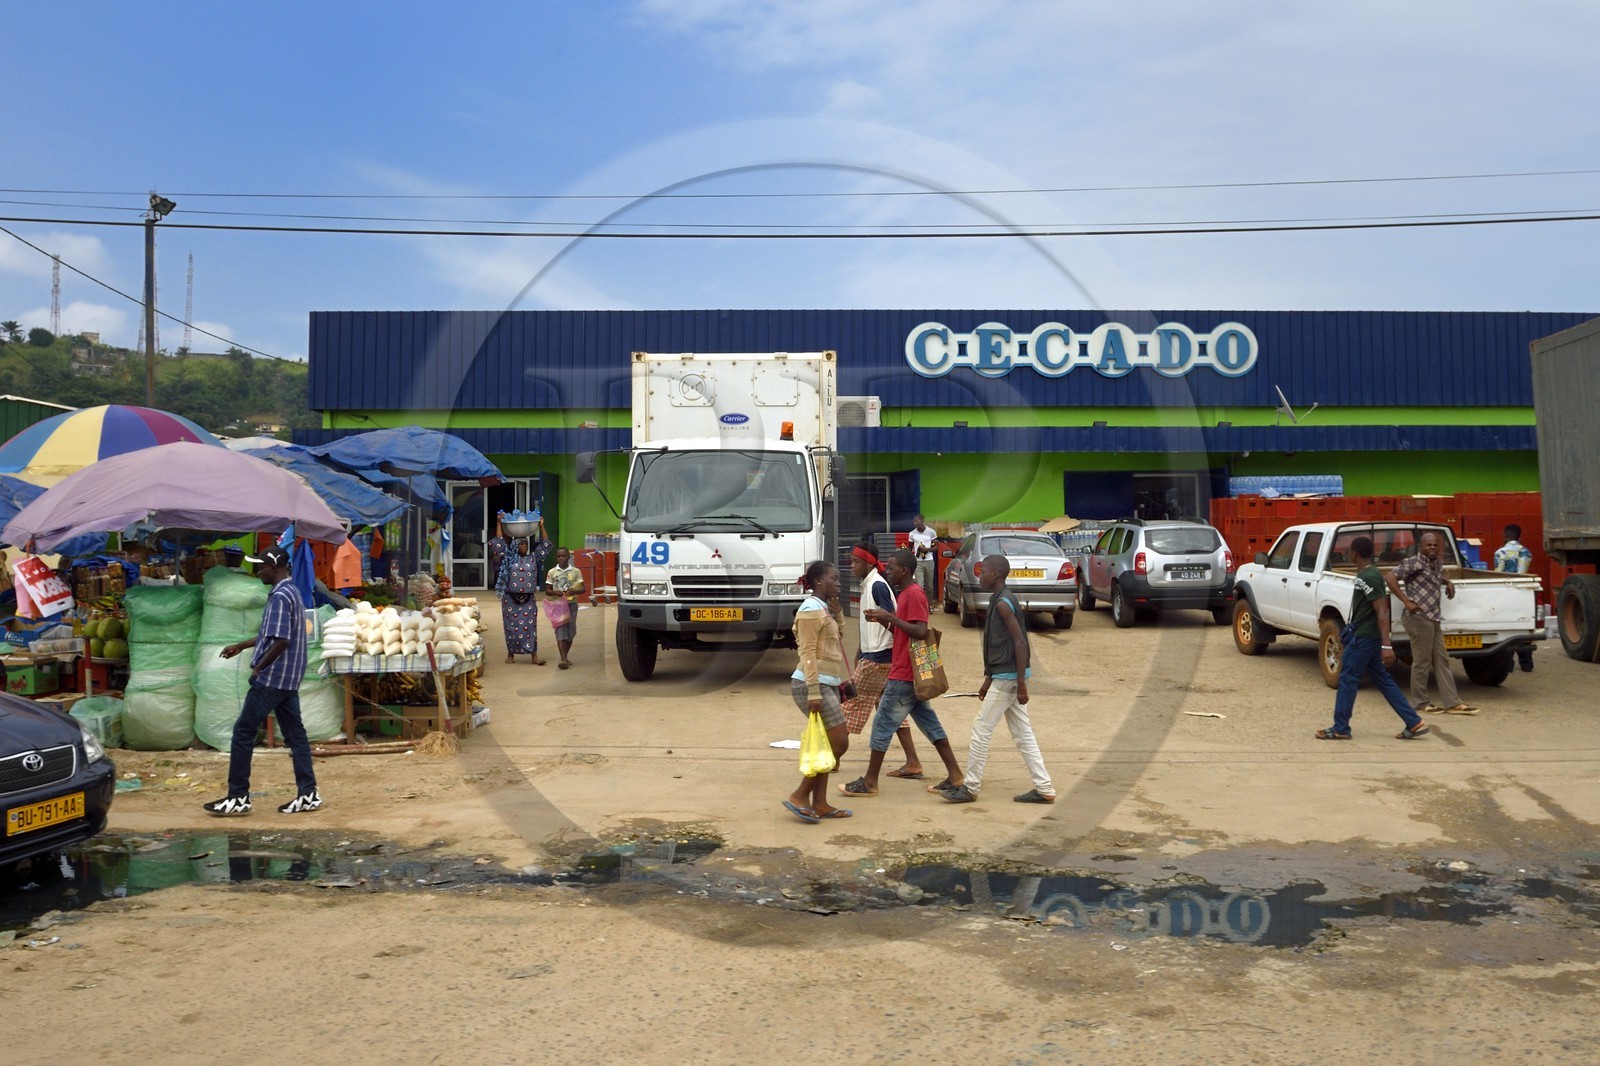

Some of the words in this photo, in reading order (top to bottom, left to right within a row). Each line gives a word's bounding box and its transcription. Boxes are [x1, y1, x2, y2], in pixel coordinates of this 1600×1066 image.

[913, 328, 1251, 370] CECADO
[631, 541, 670, 565] 49
[696, 609, 737, 618] DC-186-AA
[17, 798, 76, 828] BU-791-AA
